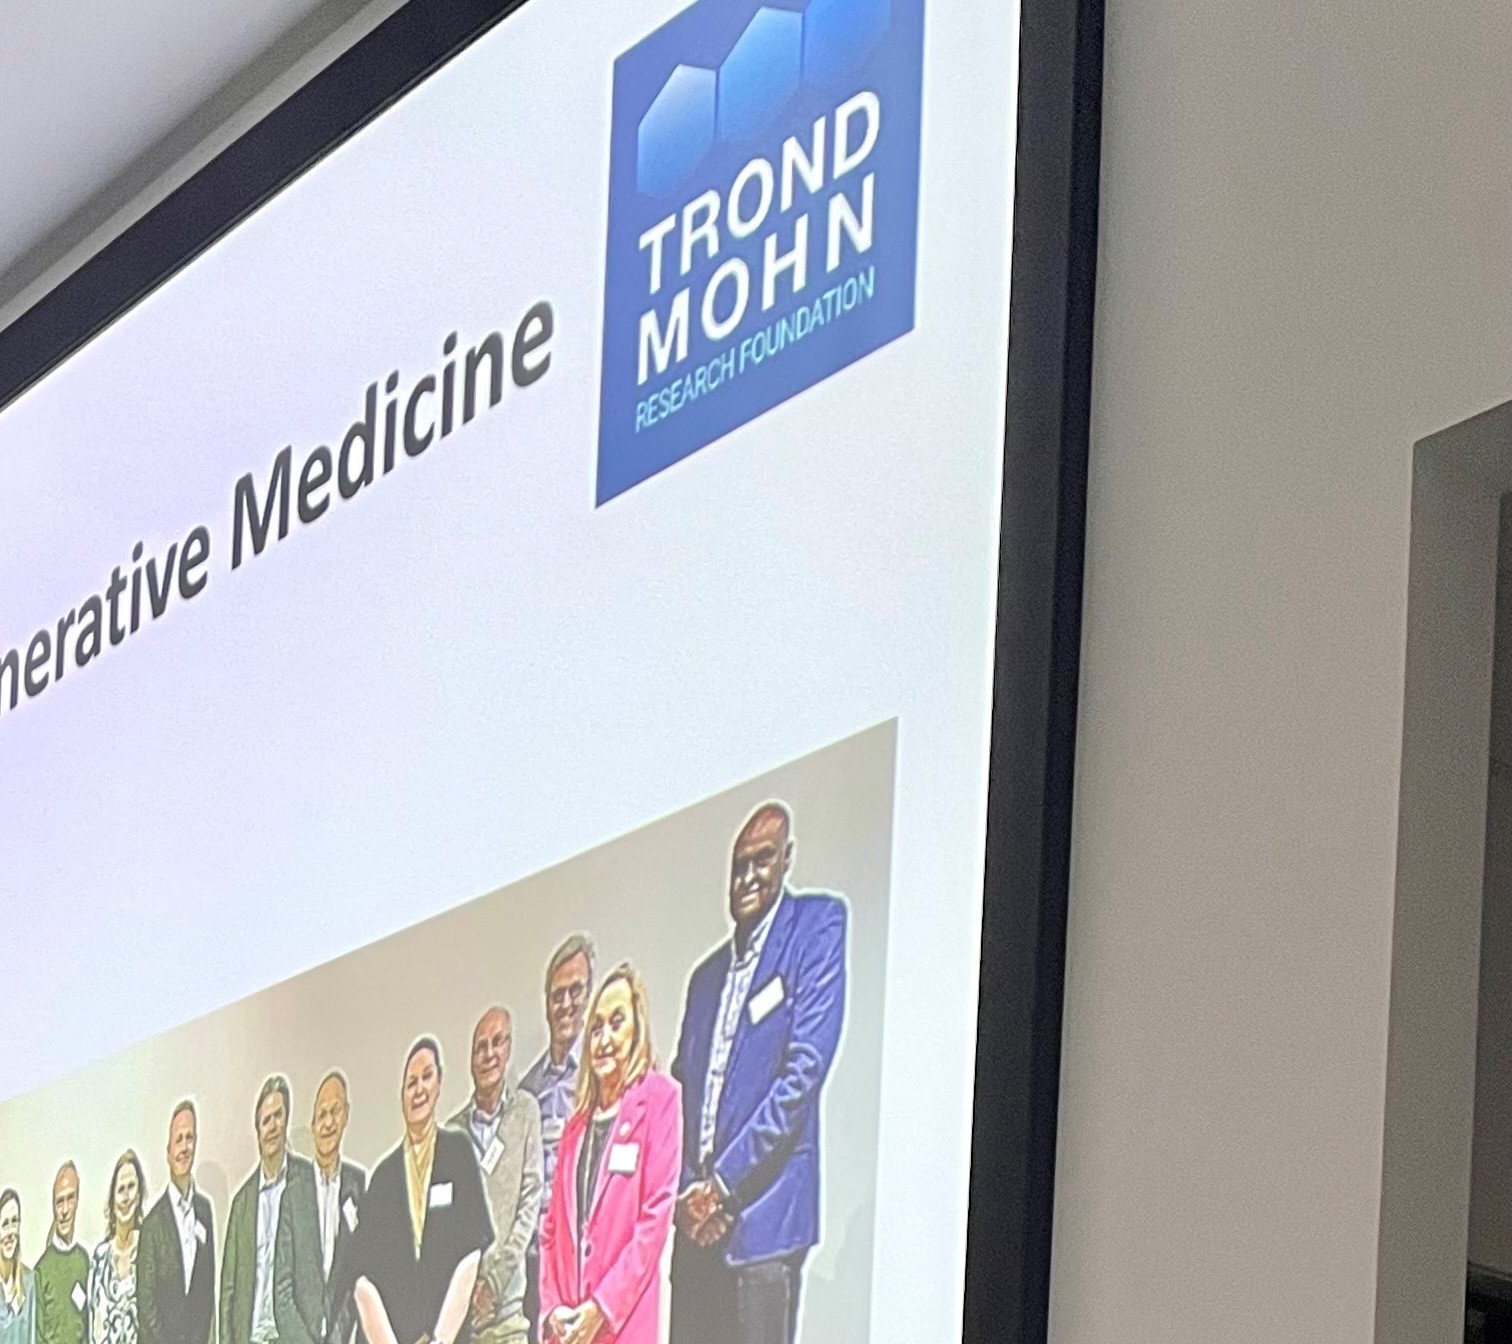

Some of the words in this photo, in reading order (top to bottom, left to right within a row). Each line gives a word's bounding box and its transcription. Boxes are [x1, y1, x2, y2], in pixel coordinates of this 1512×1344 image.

[637, 172, 875, 385] MOHN
[638, 91, 880, 295] TROND
[231, 300, 554, 571] Medicine
[635, 352, 735, 433] RESEARCH
[740, 266, 876, 375] FOUNDATION
